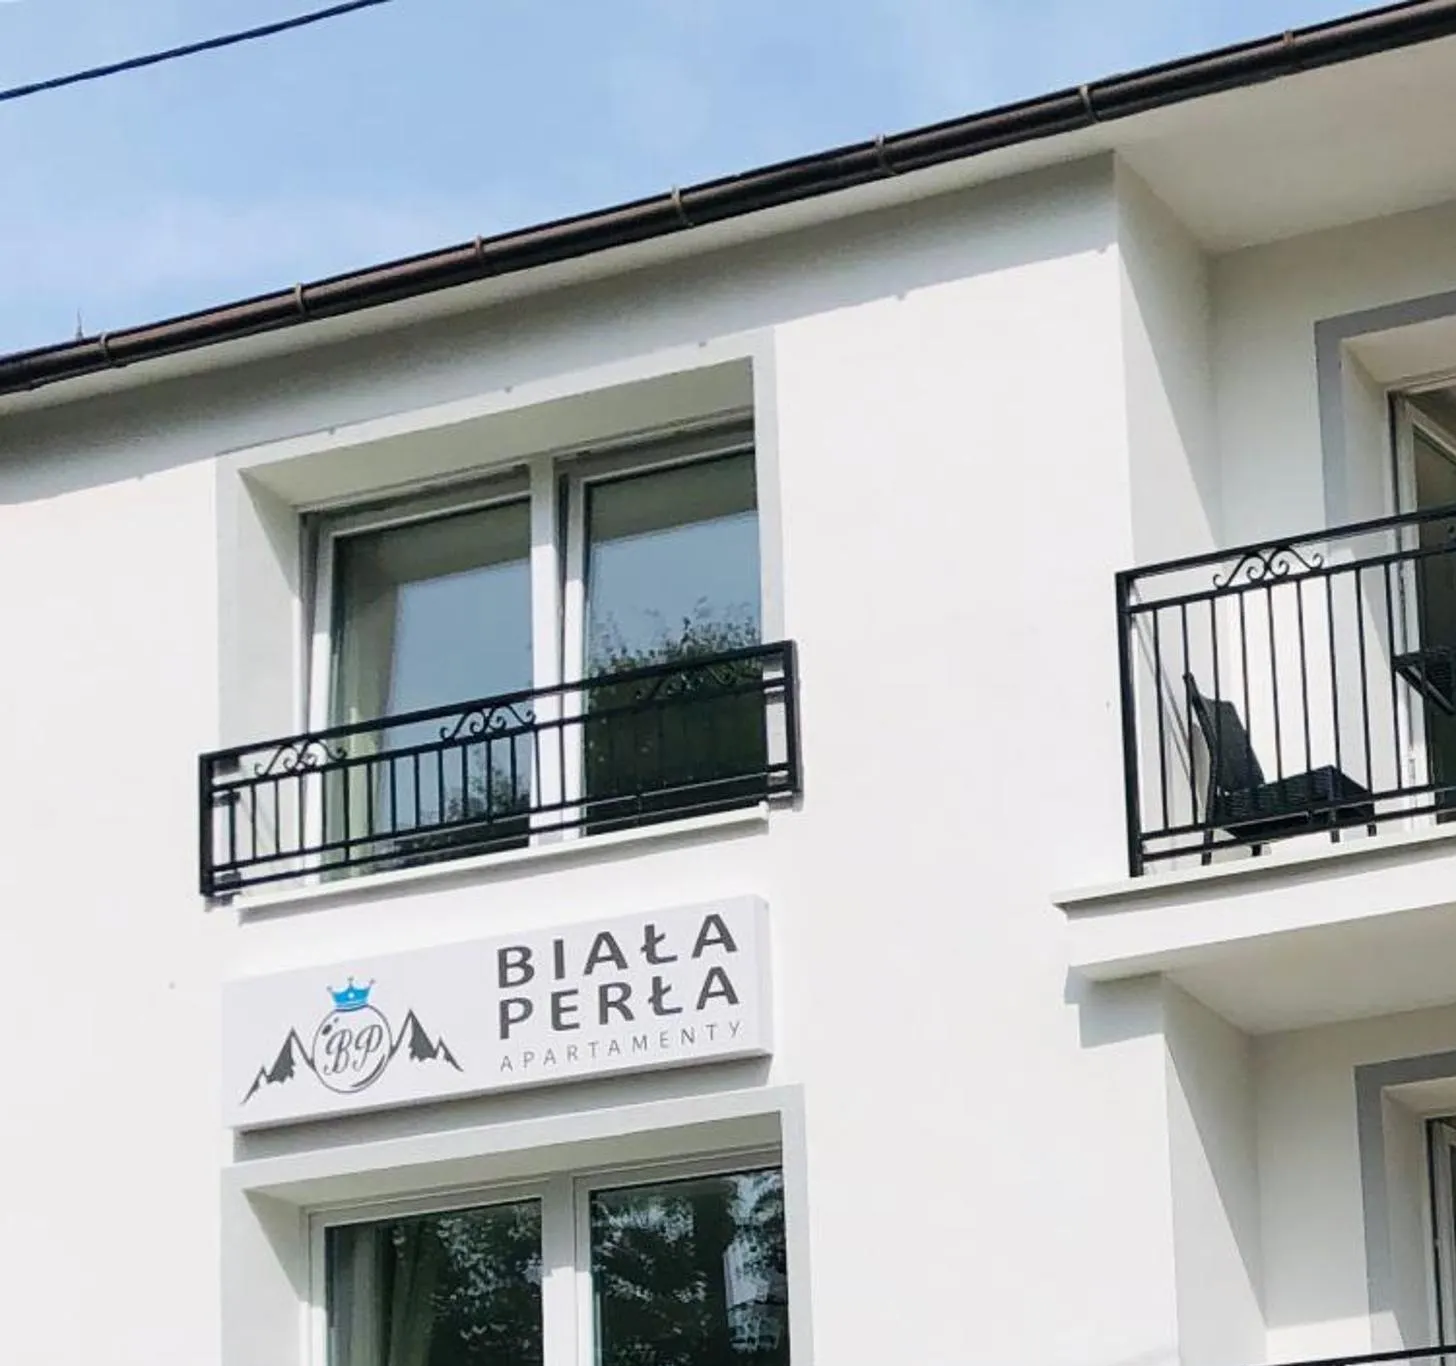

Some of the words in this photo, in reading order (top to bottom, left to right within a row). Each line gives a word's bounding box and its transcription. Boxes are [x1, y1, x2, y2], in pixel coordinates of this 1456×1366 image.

[497, 912, 738, 989] BIAŁA
[499, 965, 741, 1040] PERŁA
[499, 1020, 744, 1073] APARTAMENTY
